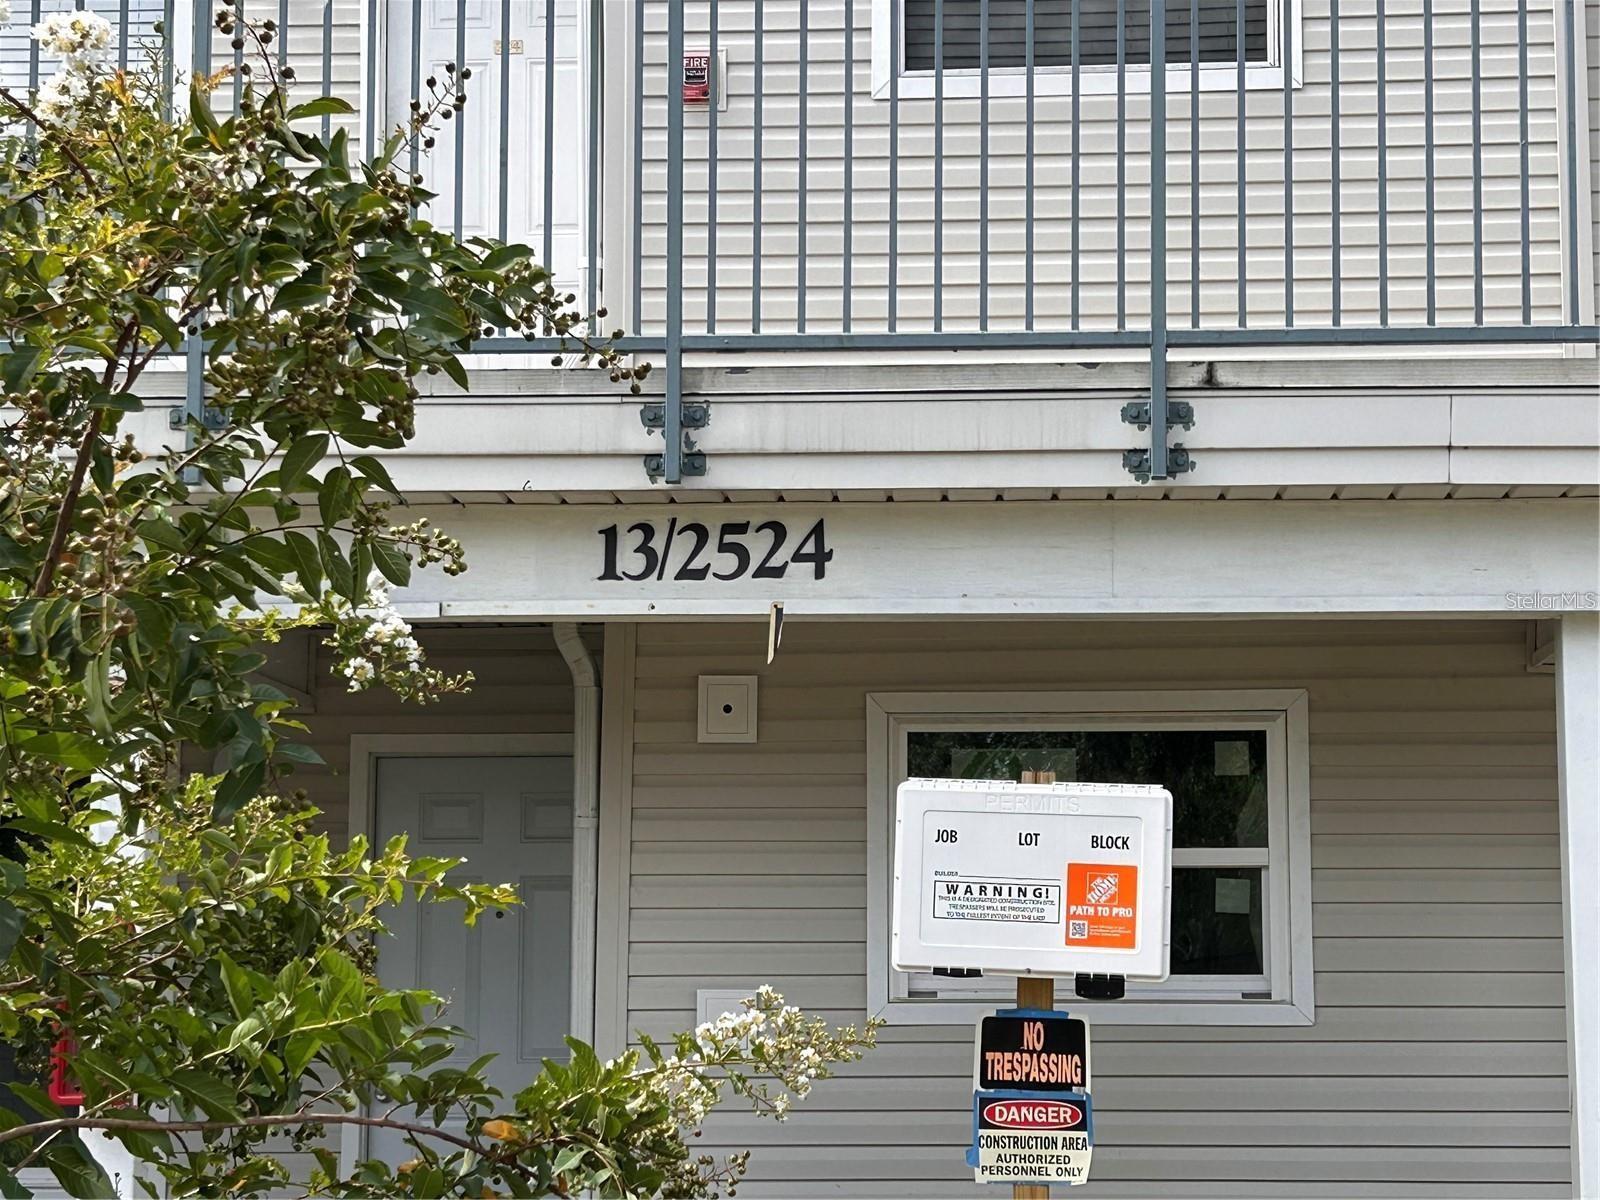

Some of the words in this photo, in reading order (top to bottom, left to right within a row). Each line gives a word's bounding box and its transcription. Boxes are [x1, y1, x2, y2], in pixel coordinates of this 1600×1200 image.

[683, 57, 708, 67] FIRE
[597, 517, 834, 581] 13/2524
[985, 793, 1081, 814] PERMITS
[935, 829, 958, 843] JOB
[1018, 832, 1041, 846] LOT
[1091, 835, 1130, 850] BLOCK
[946, 884, 1049, 899] WARNING!
[1070, 905, 1095, 916] PATH
[1097, 907, 1109, 917] TO
[1112, 907, 1133, 917] PRO
[1023, 1021, 1044, 1051] NO
[985, 1052, 1082, 1084] TRESPASSING
[994, 1106, 1072, 1123] DANGER
[979, 1134, 1058, 1150] CONSTRUCTION
[1061, 1136, 1088, 1151] AREA
[996, 1153, 1071, 1165] AUTHORIZED
[981, 1165, 1051, 1176] PERSONNEL
[1056, 1167, 1083, 1177] ONLY
